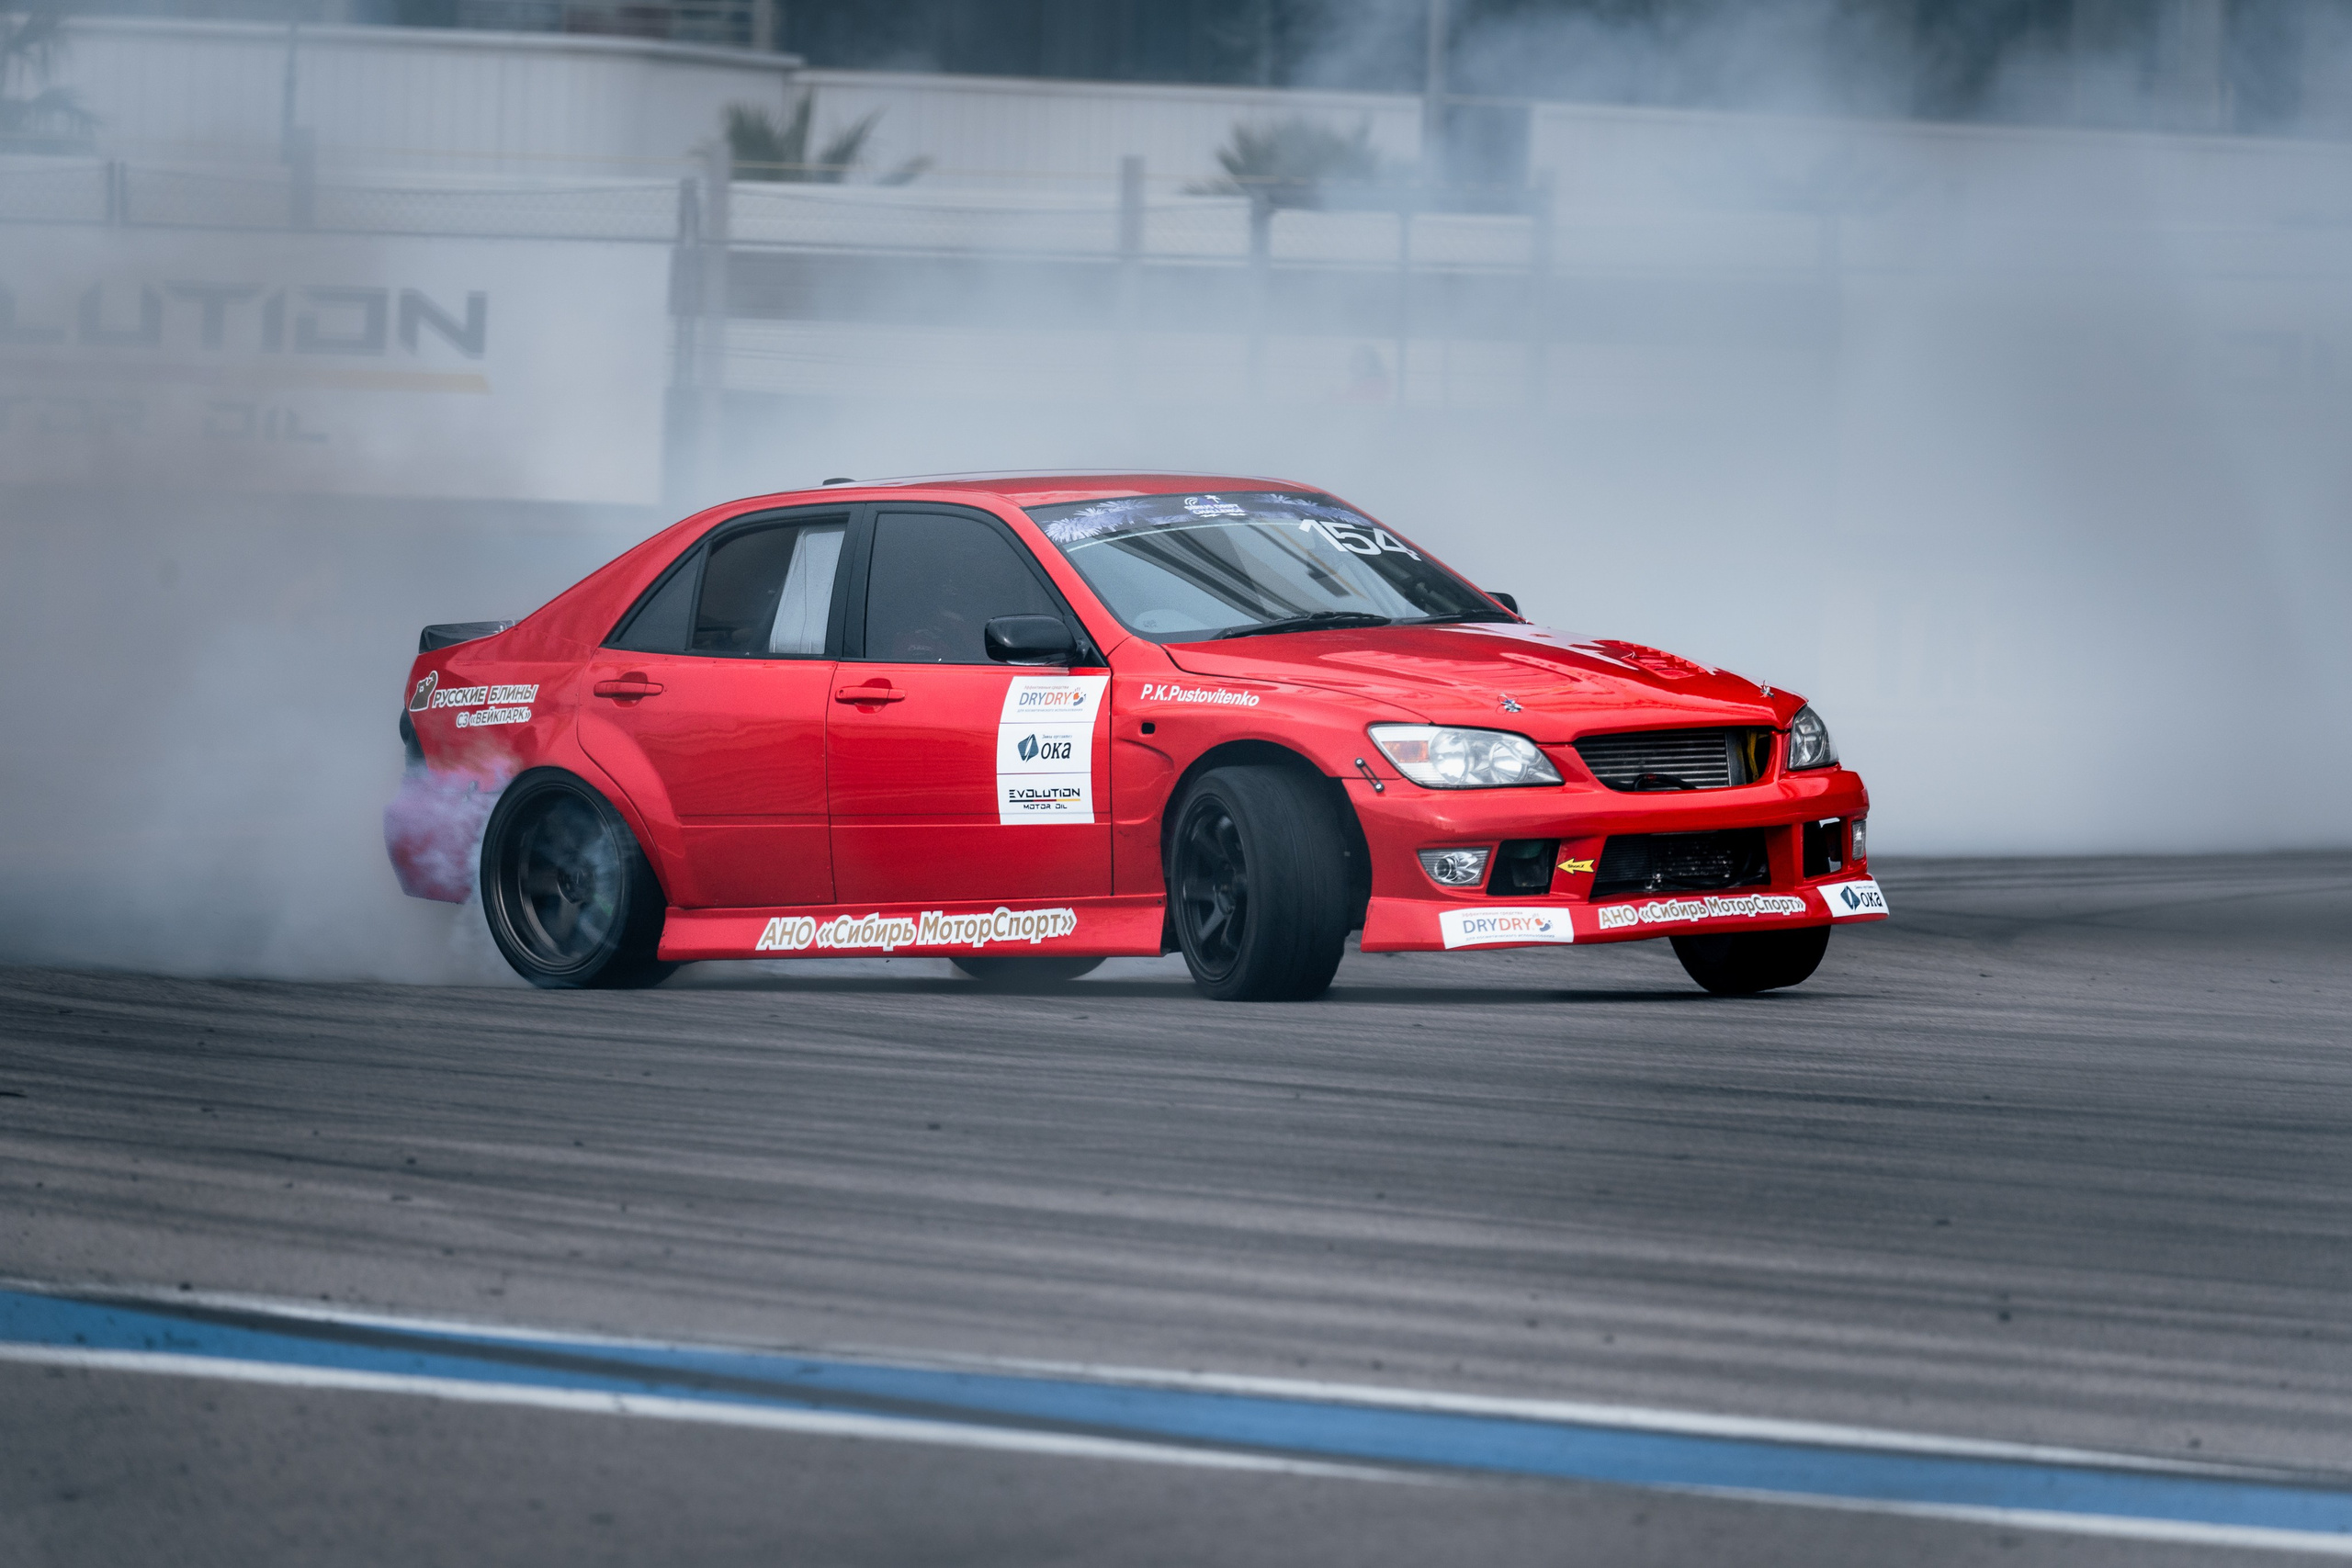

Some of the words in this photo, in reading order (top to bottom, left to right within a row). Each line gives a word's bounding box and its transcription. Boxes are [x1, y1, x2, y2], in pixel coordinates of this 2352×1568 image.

[1298, 518, 1422, 561] 154
[433, 687, 487, 707] РУССКИЕ
[489, 685, 538, 704] БЛИНЫ
[1018, 692, 1072, 705] DRYDRY
[1139, 683, 1260, 706] P.K.Pustovitenko
[1009, 788, 1080, 798] EVOLUTION
[1600, 906, 1637, 927] АНО
[1640, 900, 1708, 921] «Сибирь
[1707, 896, 1805, 915] МоторСпорт»
[758, 919, 814, 948] АНО
[817, 915, 915, 949] «Сибирь
[919, 909, 1076, 945] МоторСпорт»
[1463, 918, 1532, 934] DRYDRY
